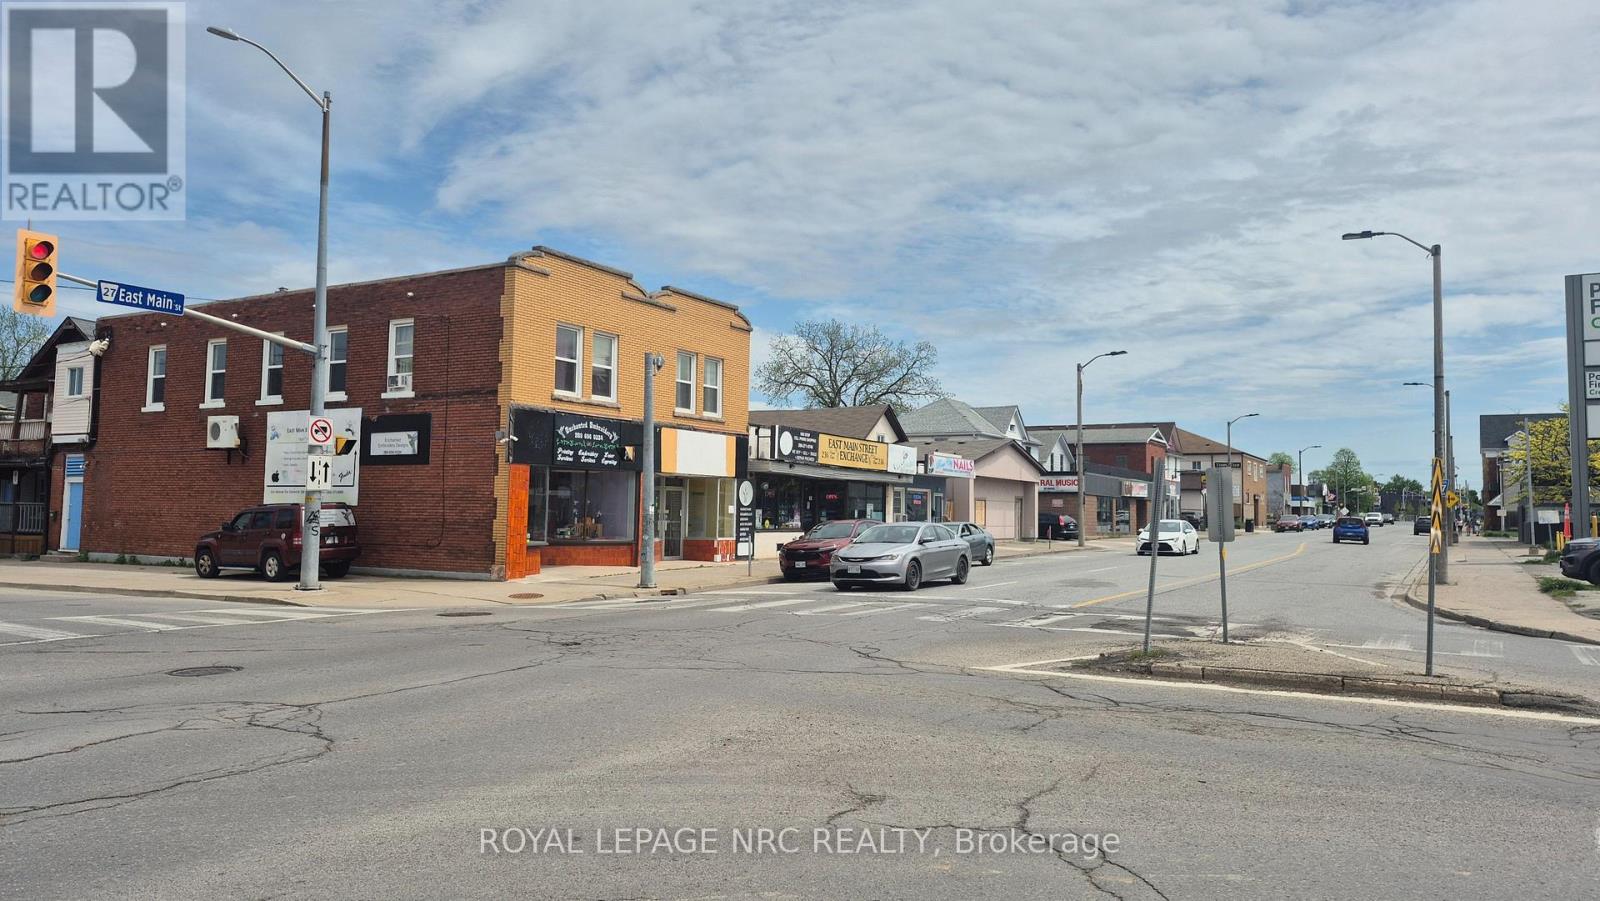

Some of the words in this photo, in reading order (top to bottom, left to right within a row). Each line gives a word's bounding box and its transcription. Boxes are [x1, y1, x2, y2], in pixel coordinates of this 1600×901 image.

[103, 287, 116, 298] 27
[118, 288, 143, 305] East
[146, 293, 173, 310] Main
[828, 438, 843, 449] EAST
[843, 440, 859, 452] MAIN
[859, 443, 878, 455] STREET
[839, 450, 868, 464] EXCHANGE
[953, 458, 974, 471] NAILS
[1055, 479, 1079, 487] MUSIC
